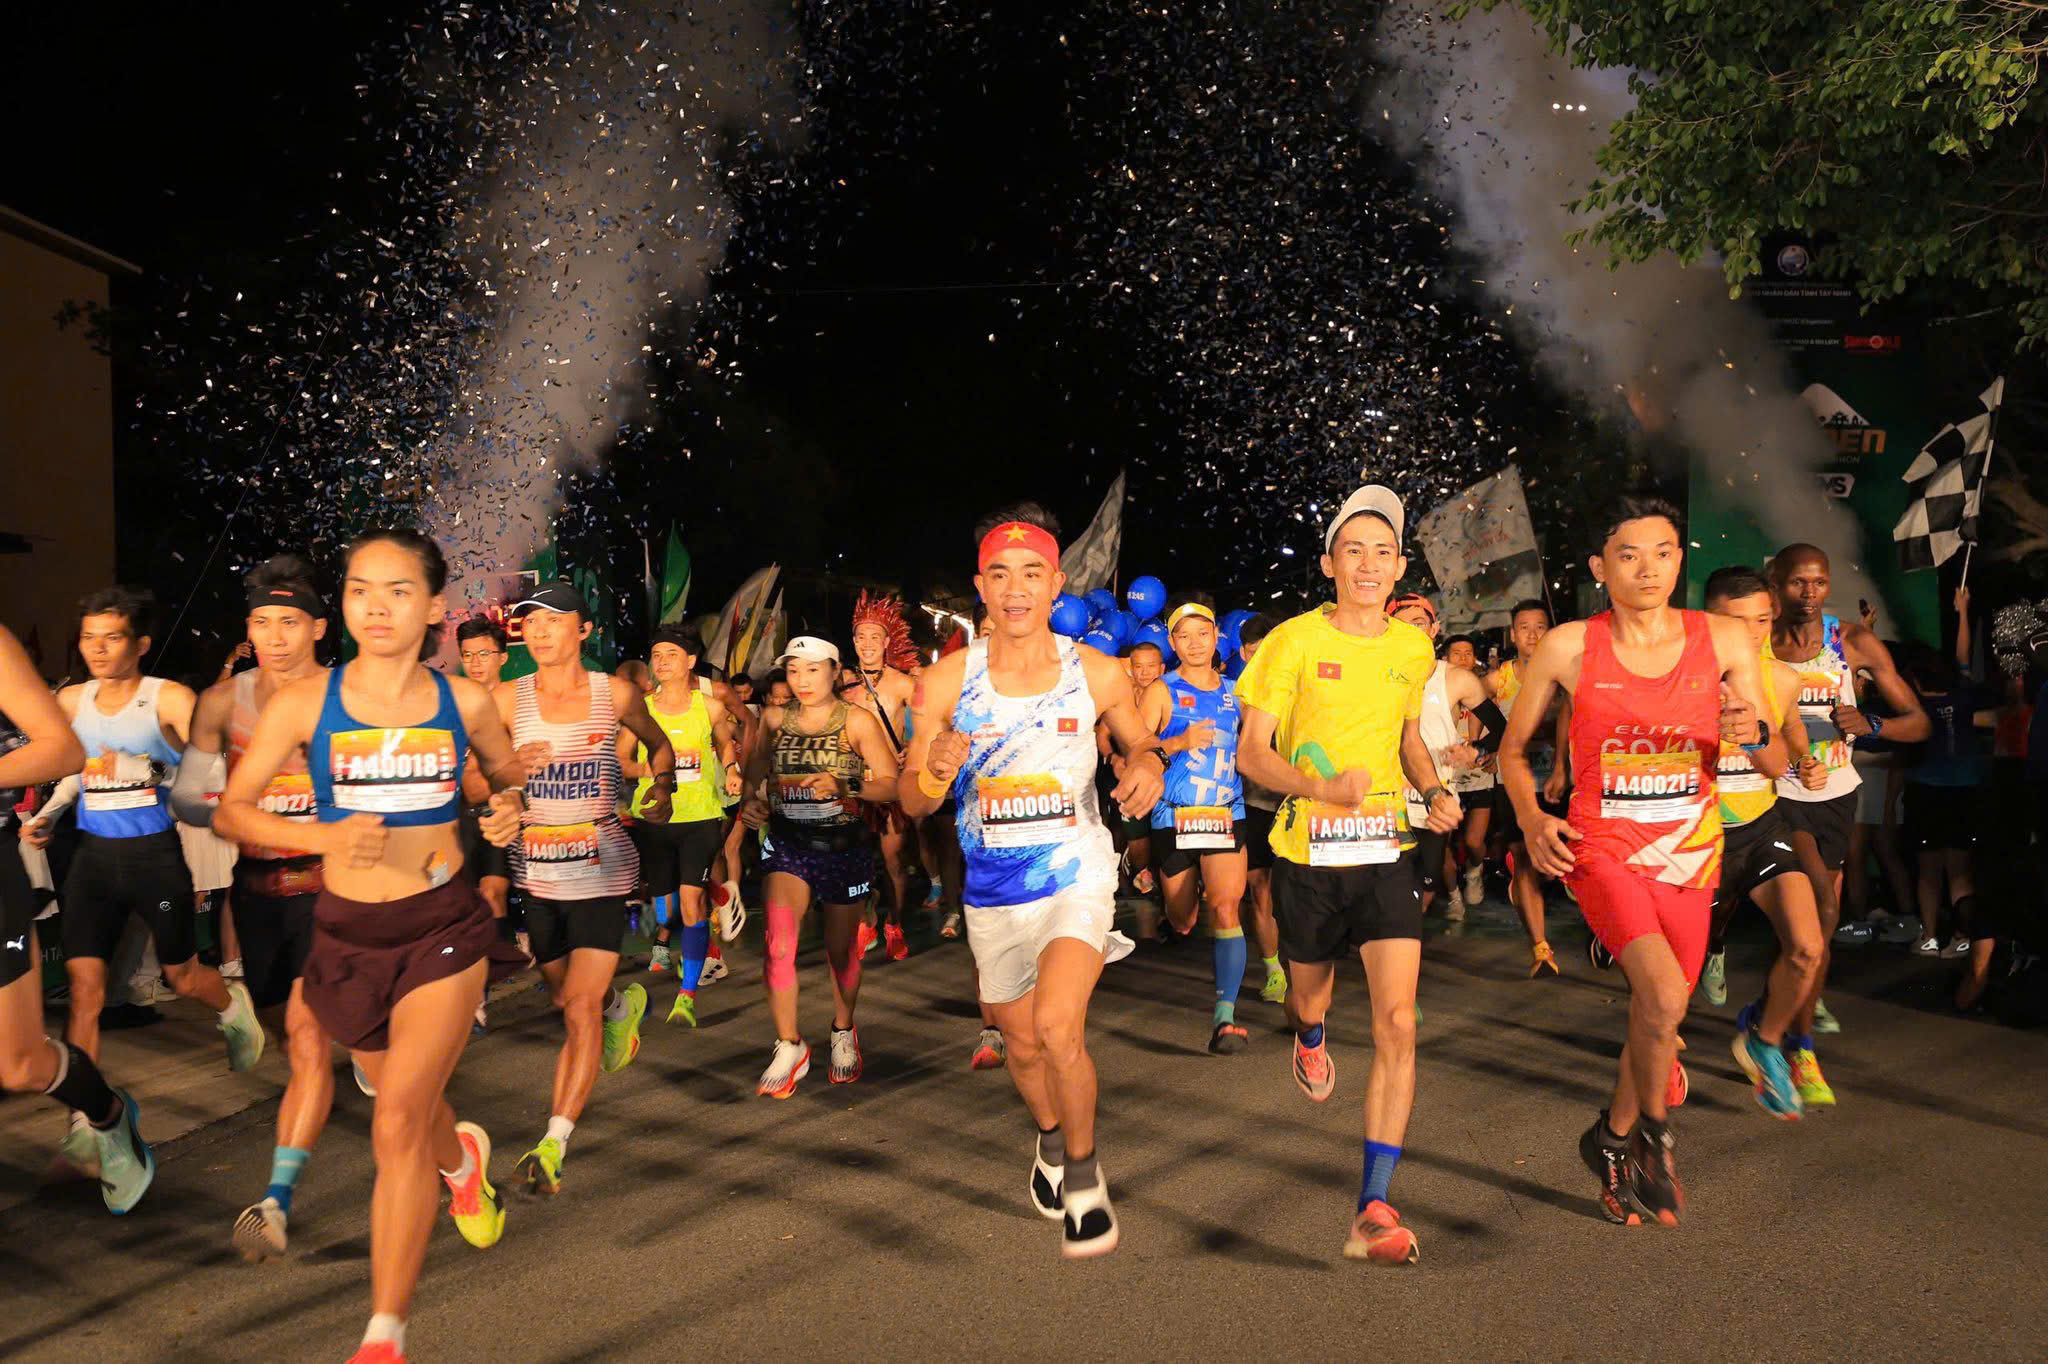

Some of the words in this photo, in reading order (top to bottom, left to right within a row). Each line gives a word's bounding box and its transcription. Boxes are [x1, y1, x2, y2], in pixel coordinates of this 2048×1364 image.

[1798, 687, 1828, 702] 014
[1615, 724, 1690, 735] ELITE
[778, 735, 838, 750] ELITE
[348, 753, 439, 780] A40018
[777, 750, 837, 766] TEAM
[1615, 773, 1687, 795] A40021
[990, 793, 1063, 820] A40008
[1183, 818, 1224, 833] A40031
[1320, 815, 1387, 838] A40032
[531, 839, 588, 860] A40038
